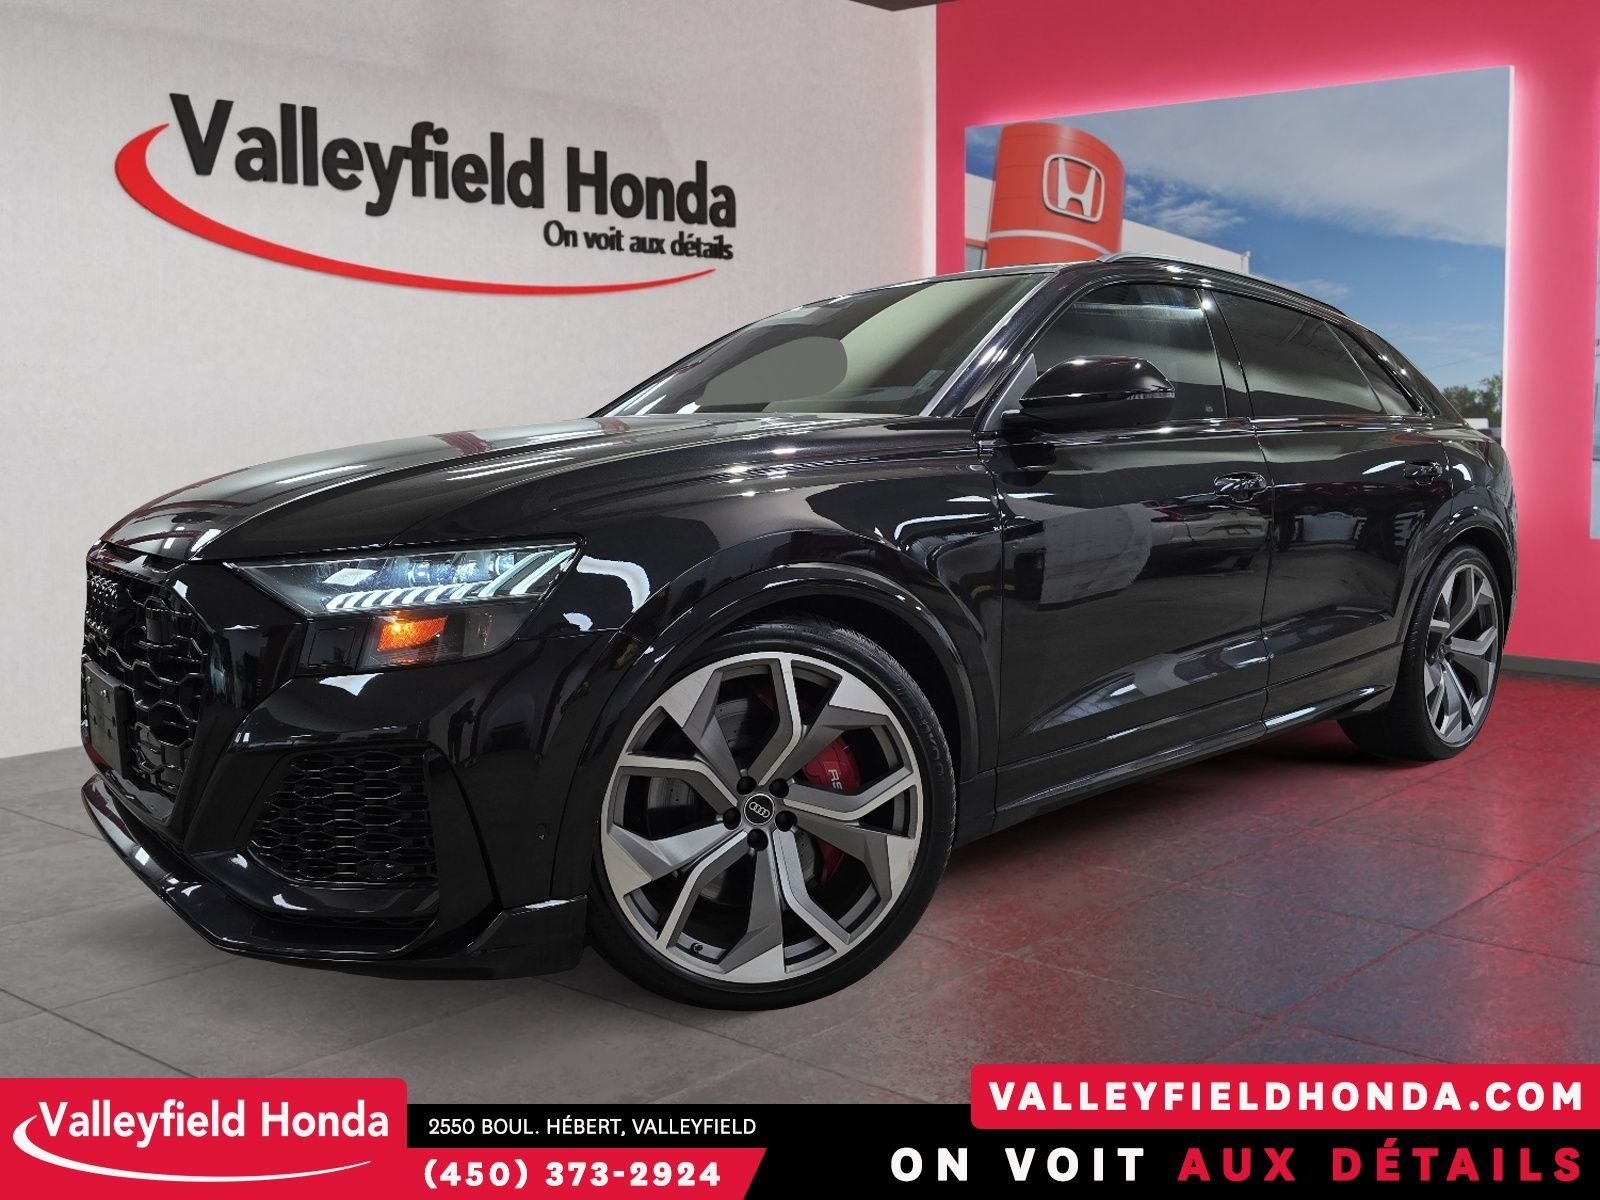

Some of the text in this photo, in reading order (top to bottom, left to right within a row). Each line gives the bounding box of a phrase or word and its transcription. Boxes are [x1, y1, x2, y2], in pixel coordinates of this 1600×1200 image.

[169, 93, 737, 228] Valleyfield Honda
[543, 219, 734, 260] On voit aux détails
